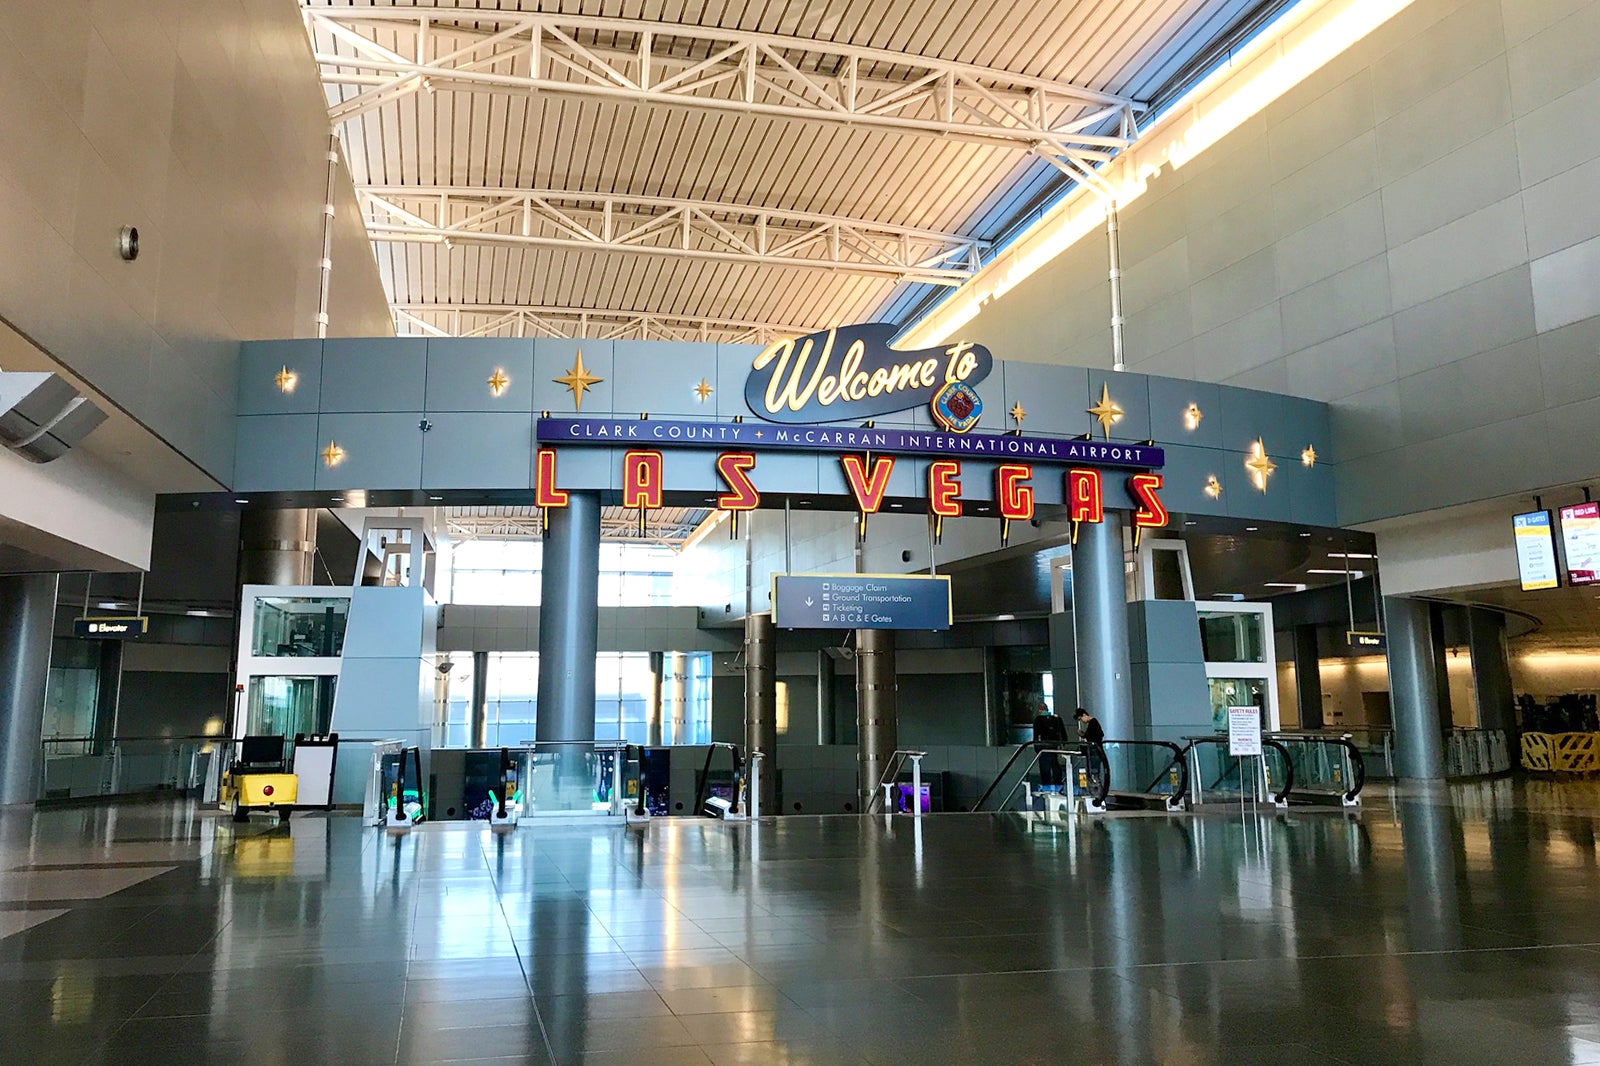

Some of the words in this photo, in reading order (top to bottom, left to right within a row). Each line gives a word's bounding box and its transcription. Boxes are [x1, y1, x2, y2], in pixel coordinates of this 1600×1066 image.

[753, 326, 938, 413] Welcome
[945, 340, 979, 383] to
[569, 423, 638, 437] CLARK
[653, 425, 742, 440] COUNTY
[776, 429, 886, 445] McCARRAN
[900, 435, 1058, 456] INTERNATIONAL
[1069, 445, 1142, 462] AIRPORT
[536, 448, 762, 511] LAS
[840, 454, 1170, 528] VEGAS
[831, 583, 864, 593] Baggage
[866, 583, 888, 592] Claim
[831, 593, 860, 602] Ground
[862, 593, 912, 604] Transportation
[832, 603, 863, 613] Ticketing
[871, 615, 893, 623] Gates
[98, 623, 128, 632] Elevator
